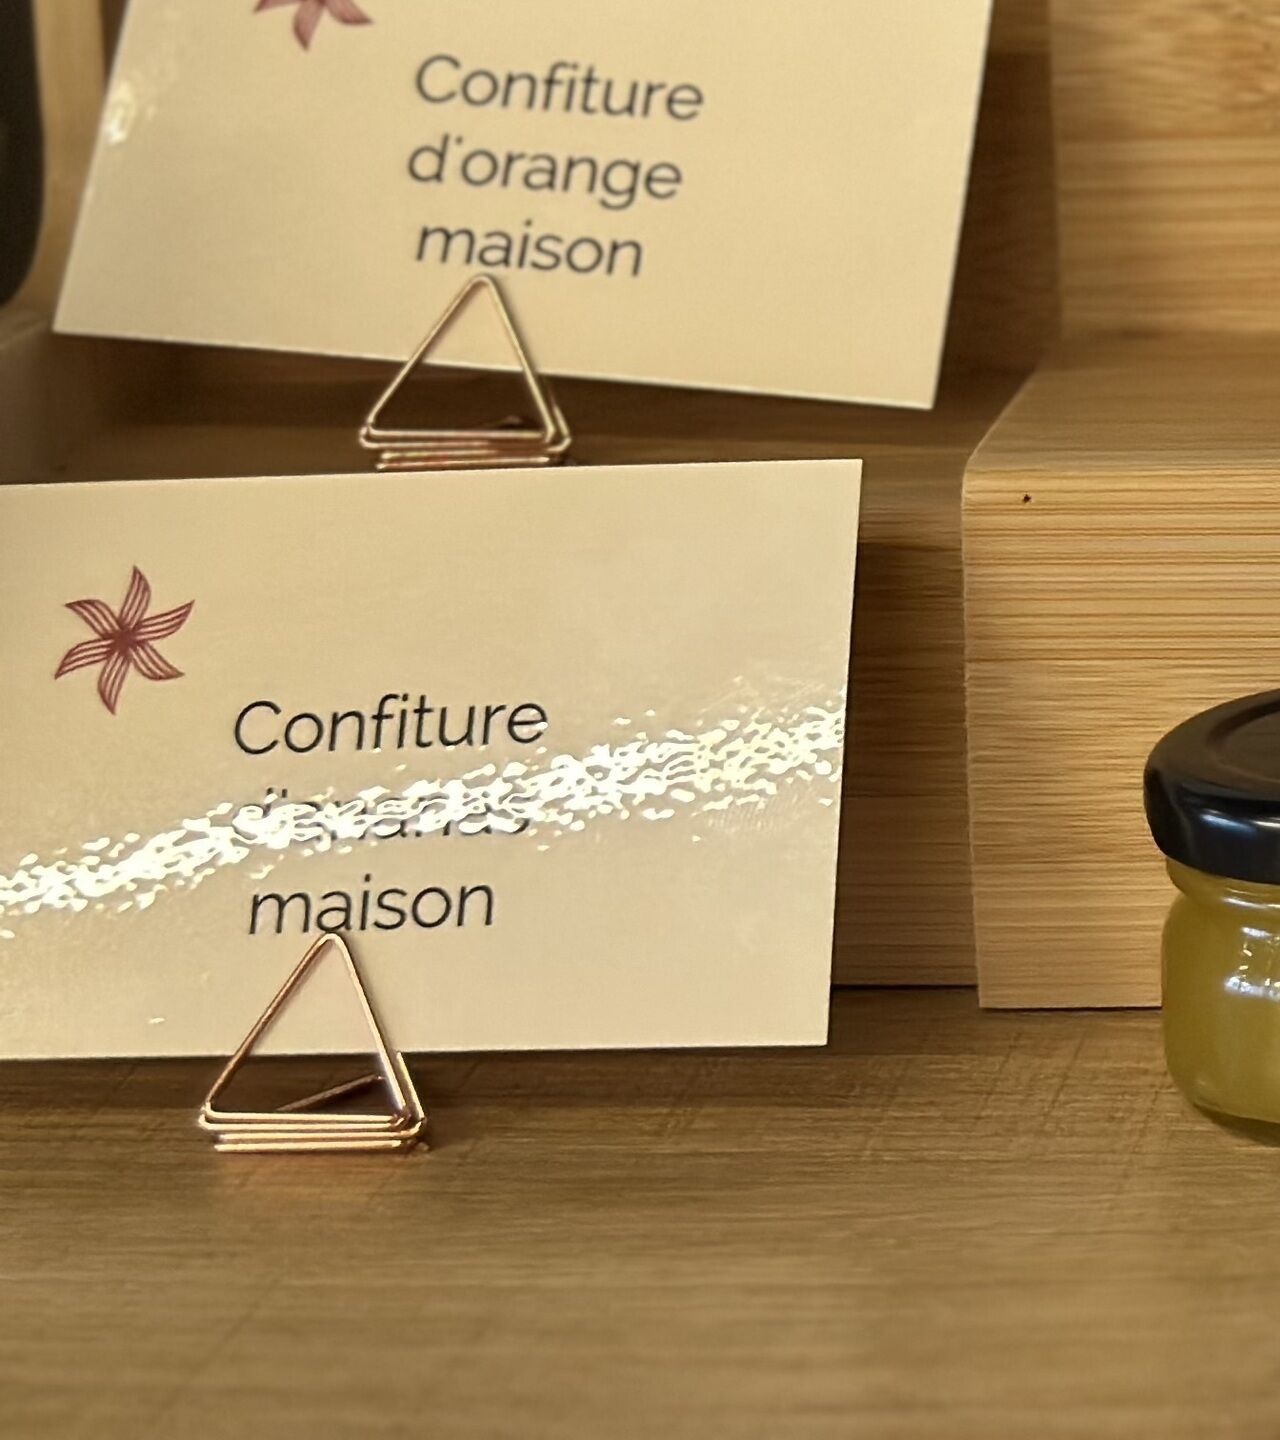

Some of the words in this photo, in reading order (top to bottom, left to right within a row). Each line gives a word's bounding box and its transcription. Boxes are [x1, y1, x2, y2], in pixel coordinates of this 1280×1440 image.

[414, 54, 704, 121] Confiture
[406, 133, 683, 211] d'orange
[414, 220, 643, 278] maison
[232, 692, 548, 757] Confiture
[248, 873, 494, 936] maison
